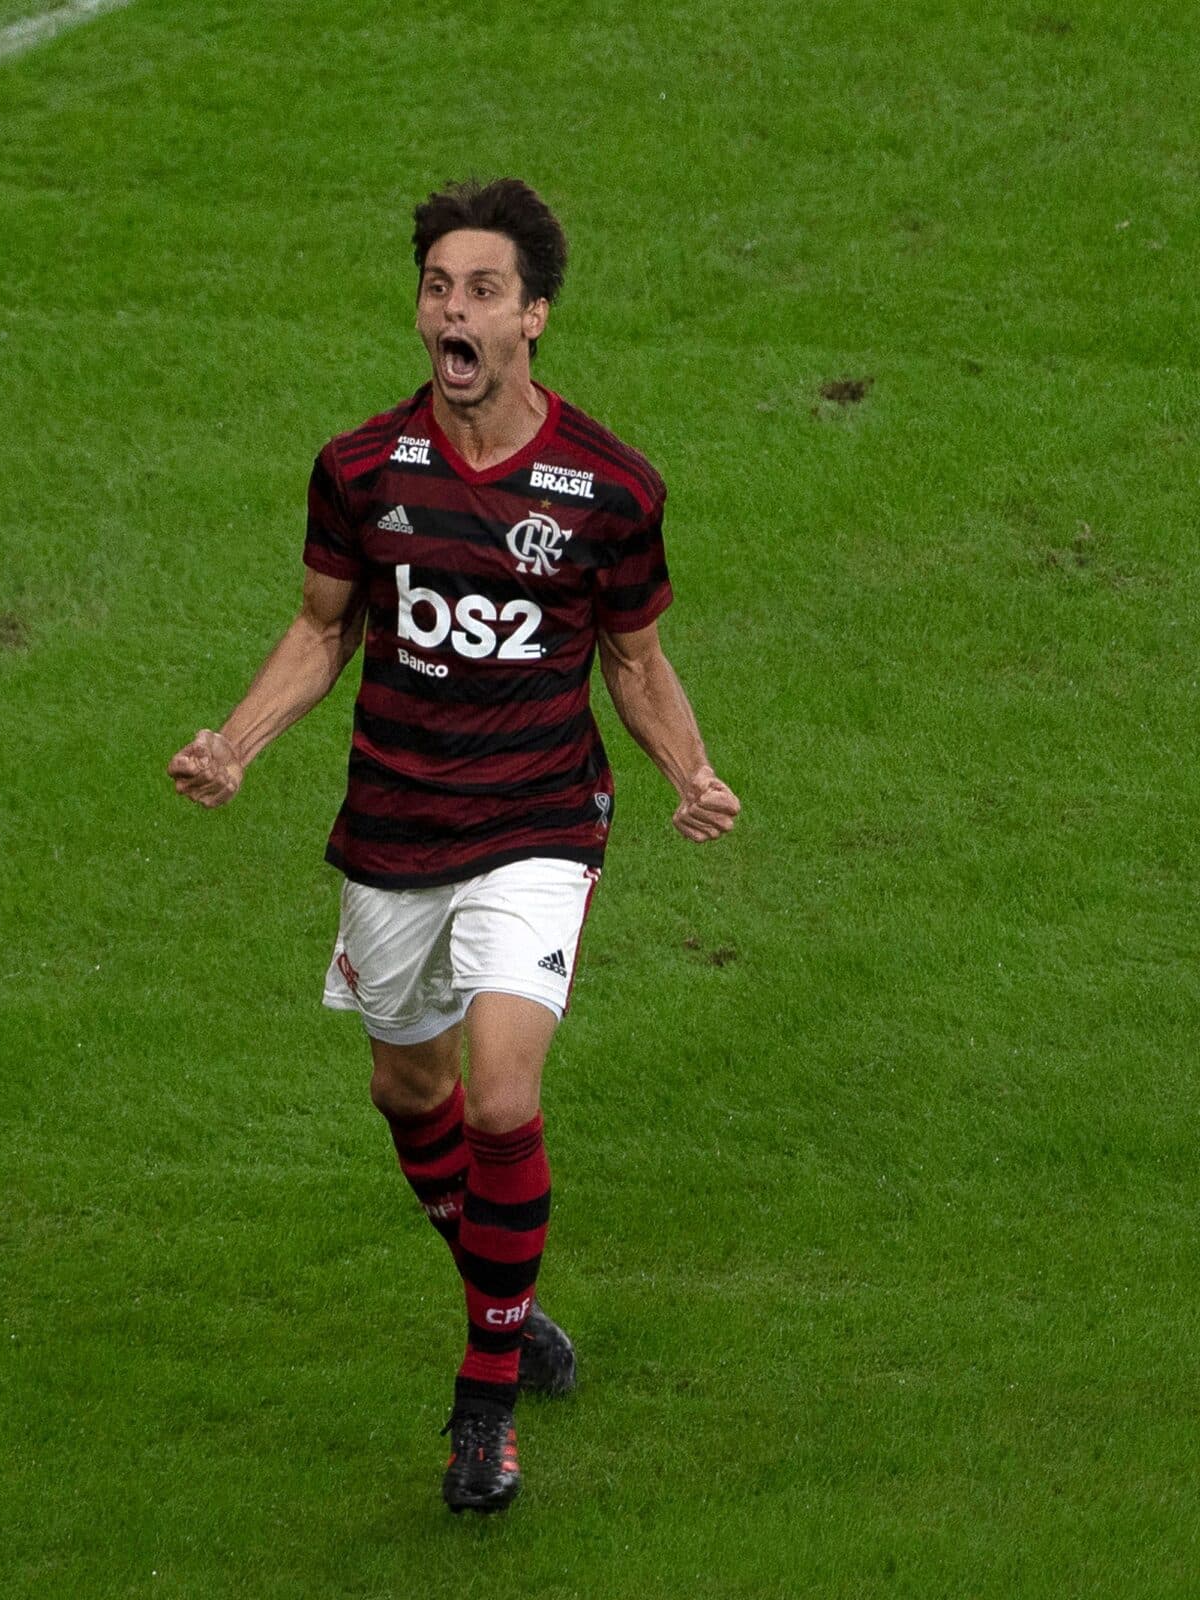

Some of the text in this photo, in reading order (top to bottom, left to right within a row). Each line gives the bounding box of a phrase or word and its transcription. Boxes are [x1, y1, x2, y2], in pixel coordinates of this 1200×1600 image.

[529, 470, 595, 499] BRASIL
[533, 462, 594, 481] UNIVERSIDADE
[377, 520, 414, 535] adidas
[395, 563, 543, 660] bs2
[397, 648, 449, 678] Banco
[486, 1297, 530, 1325] CRF
